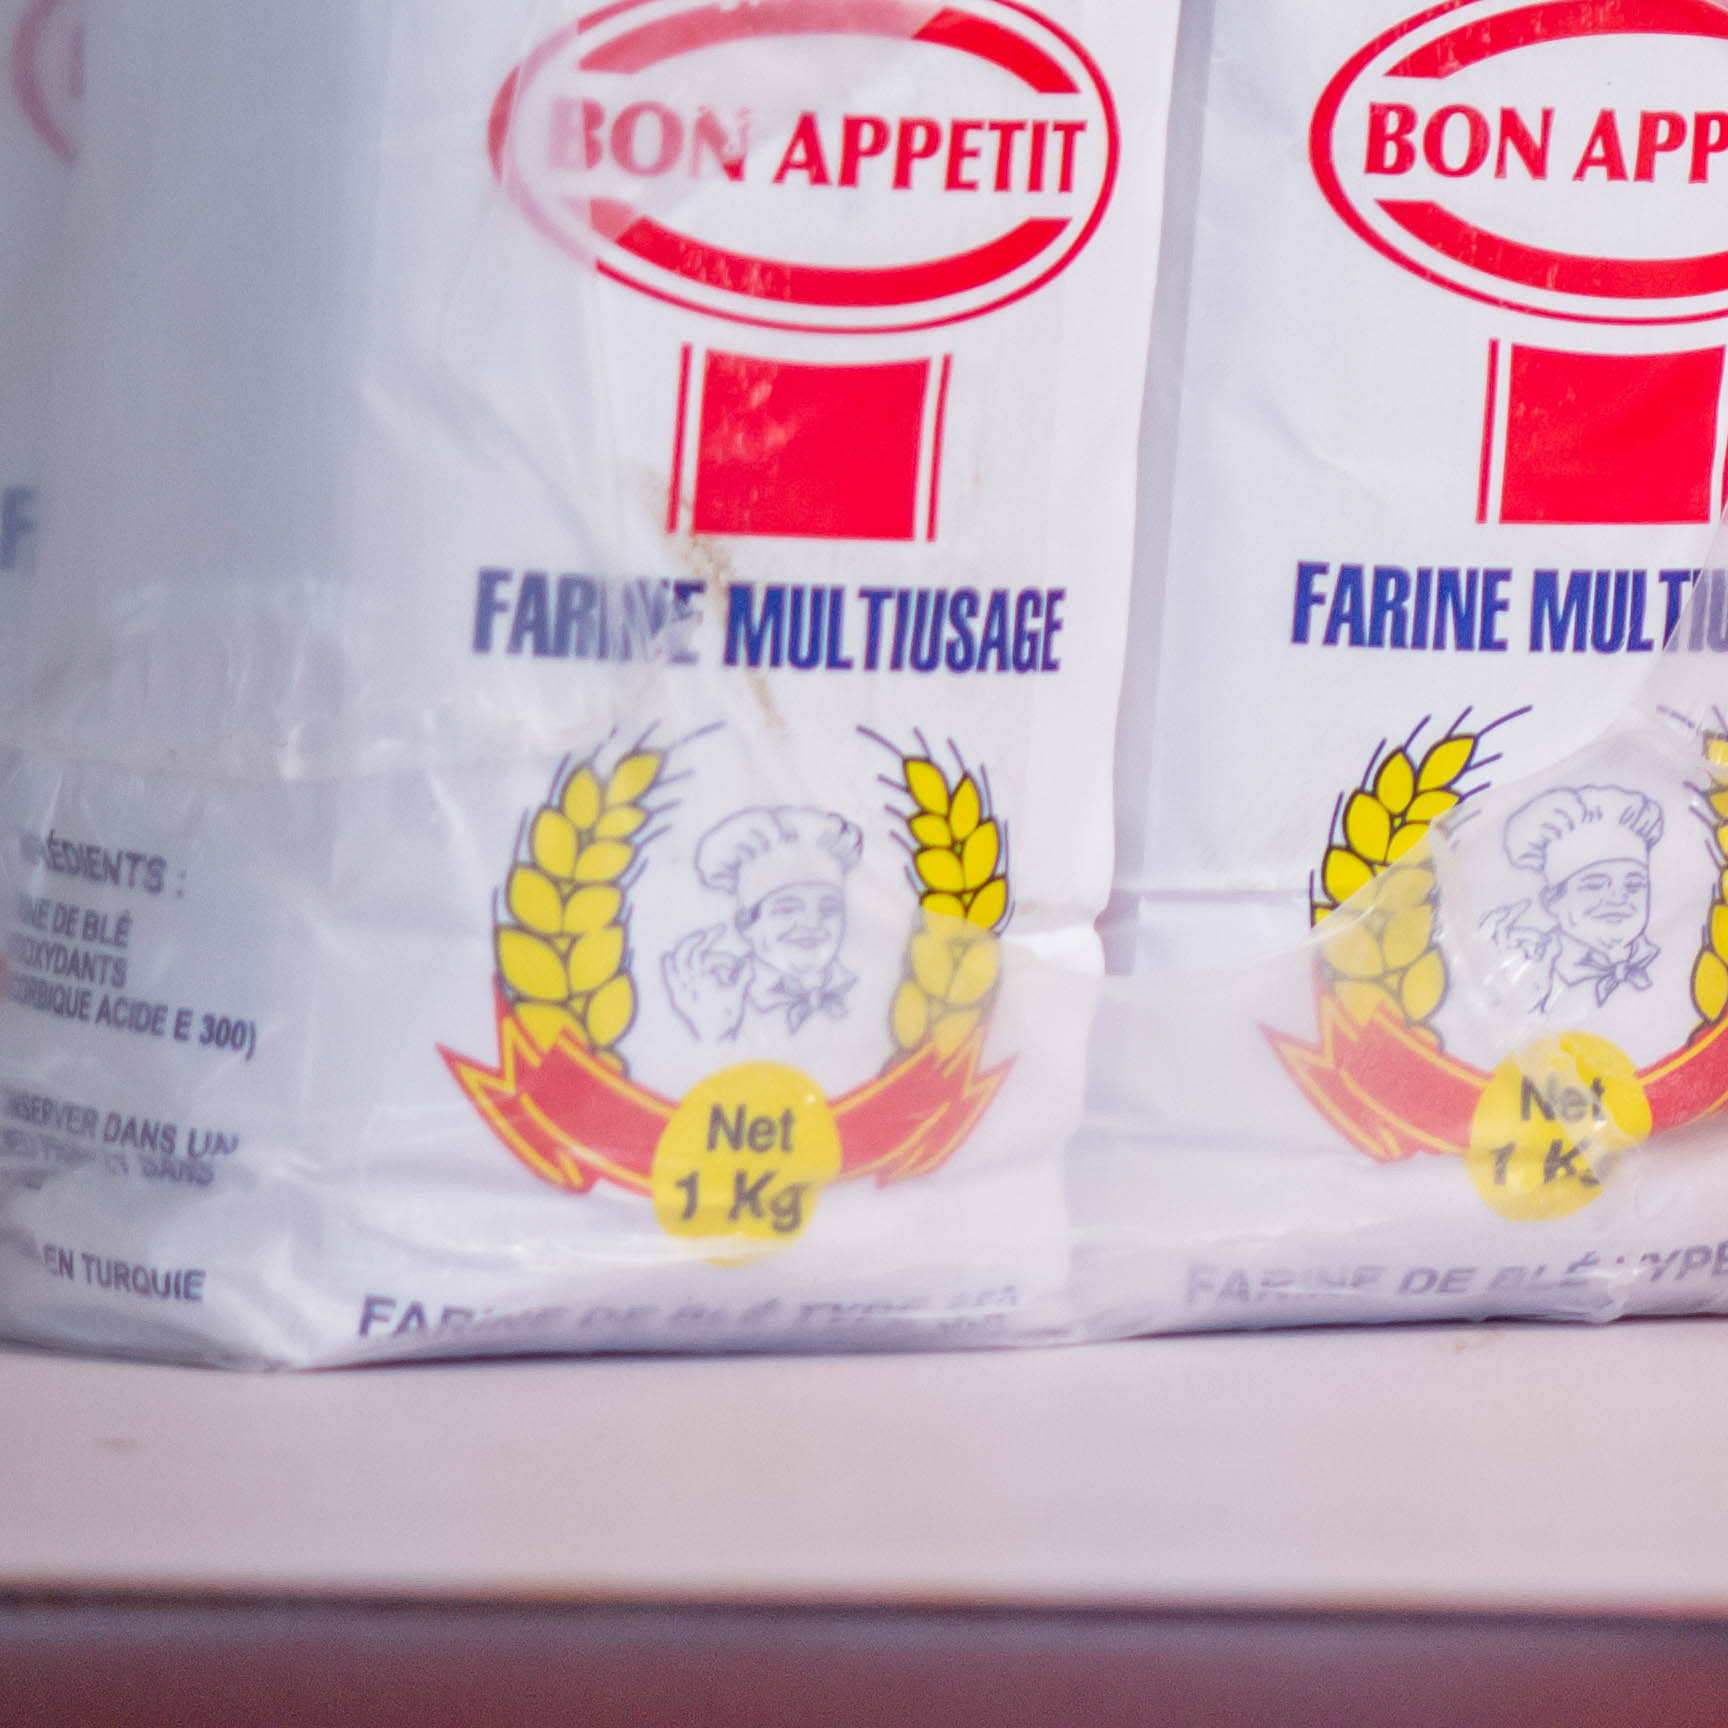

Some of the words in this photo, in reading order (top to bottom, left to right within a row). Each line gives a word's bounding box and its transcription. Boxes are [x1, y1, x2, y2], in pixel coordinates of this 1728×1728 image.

[548, 97, 757, 180] BON
[772, 113, 1088, 194] APPETIT
[1363, 101, 1556, 181] BON
[472, 566, 708, 666] FARINE
[722, 581, 1067, 673] MULTIUSAGE
[1290, 559, 1512, 652] FARINE
[96, 992, 169, 1037] ACIDE
[173, 1005, 194, 1043] E
[1520, 1073, 1606, 1123] Net
[102, 1111, 178, 1156] DANS
[705, 1103, 797, 1157] Net
[1490, 1140, 1517, 1186] 1
[677, 1170, 701, 1222] 1
[726, 1169, 805, 1234] Kg
[43, 1242, 75, 1281] EN
[80, 1250, 208, 1301] TURQUIE
[1400, 1265, 1479, 1295] DE
